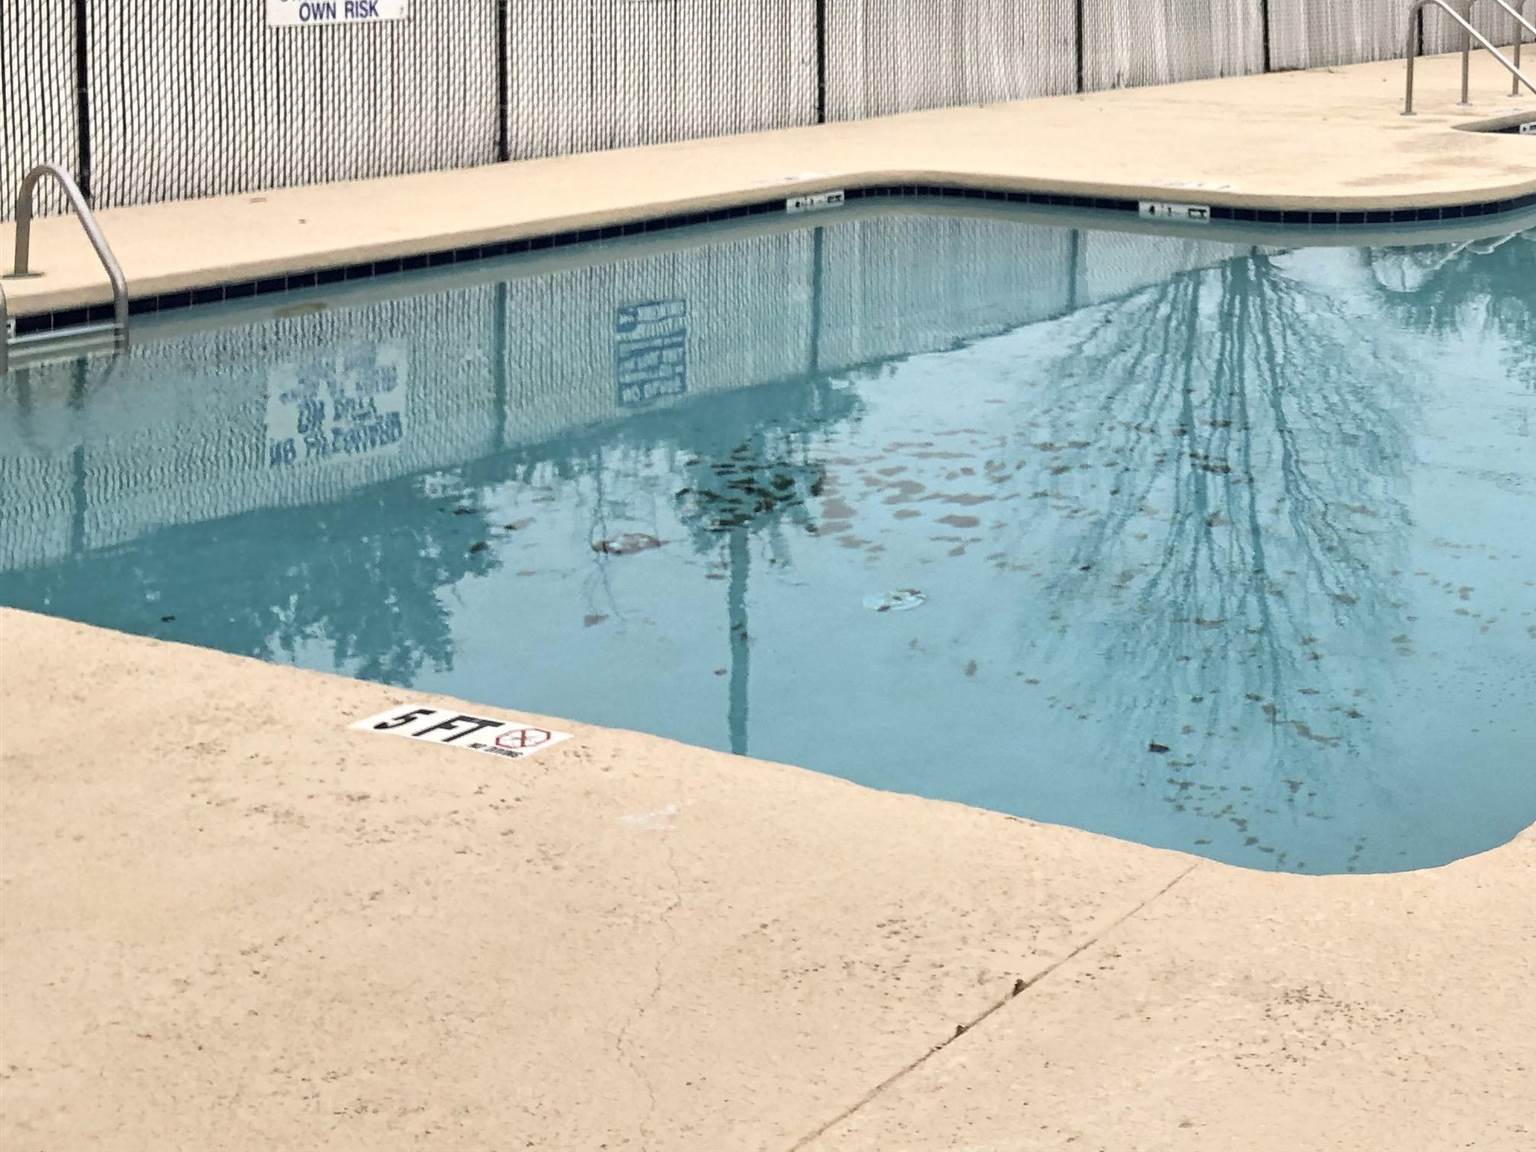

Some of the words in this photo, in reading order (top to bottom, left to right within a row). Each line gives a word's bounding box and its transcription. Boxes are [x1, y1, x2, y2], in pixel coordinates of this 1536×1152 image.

[299, 2, 336, 22] OWN
[345, 0, 379, 18] RISK
[373, 708, 437, 730] 5
[411, 714, 506, 742] FT
